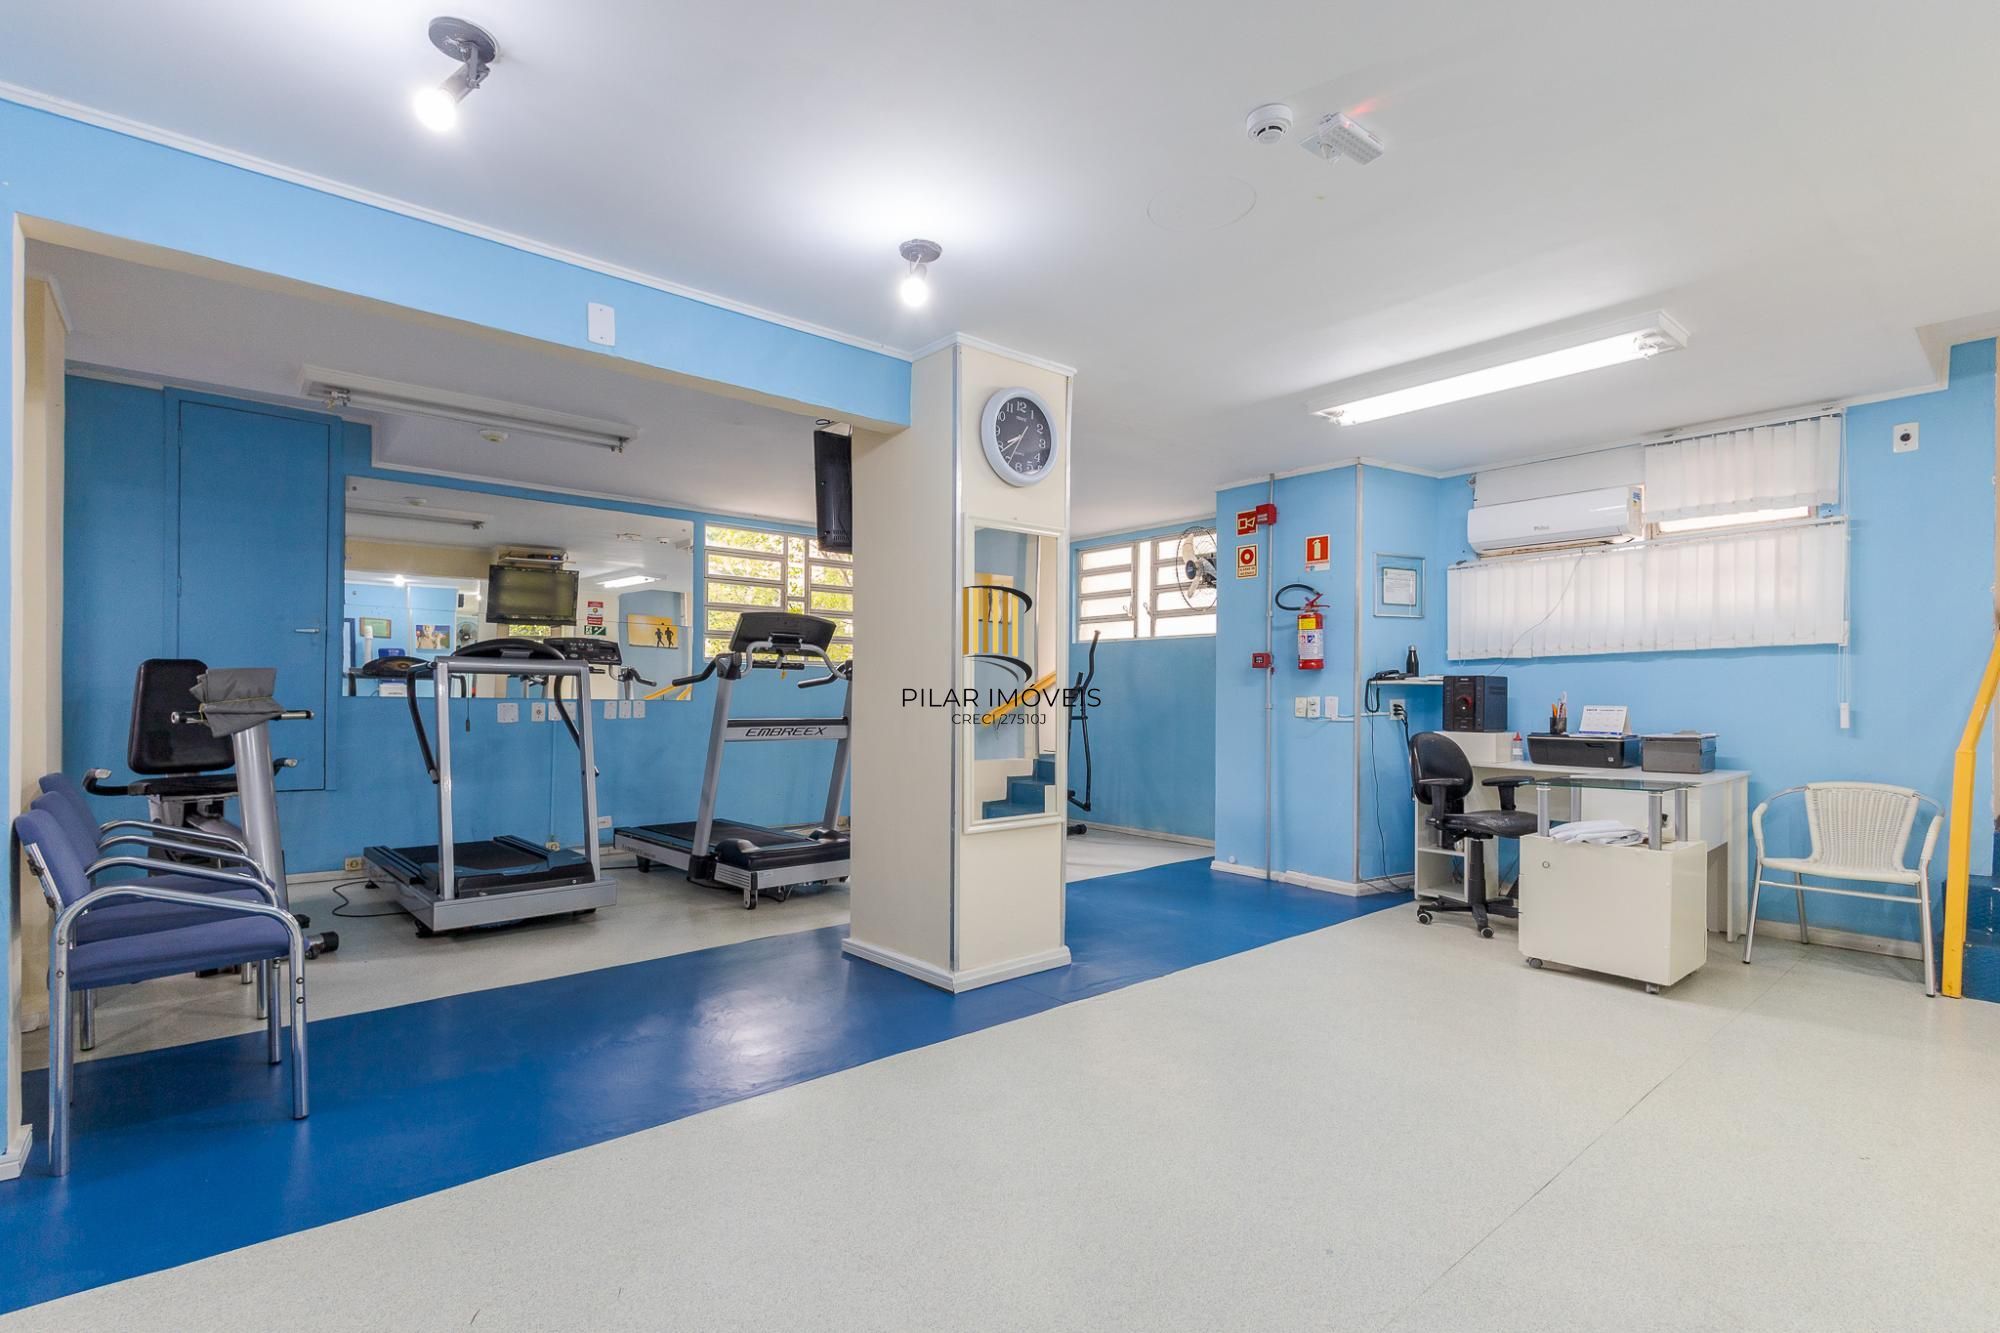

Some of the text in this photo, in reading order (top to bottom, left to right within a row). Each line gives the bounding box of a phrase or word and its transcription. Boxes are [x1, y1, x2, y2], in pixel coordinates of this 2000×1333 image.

[1016, 401, 1027, 413] 12
[1036, 423, 1044, 434] 2
[1038, 438, 1046, 449] 3
[1033, 452, 1041, 462] 4
[745, 727, 827, 737] EMBREEX
